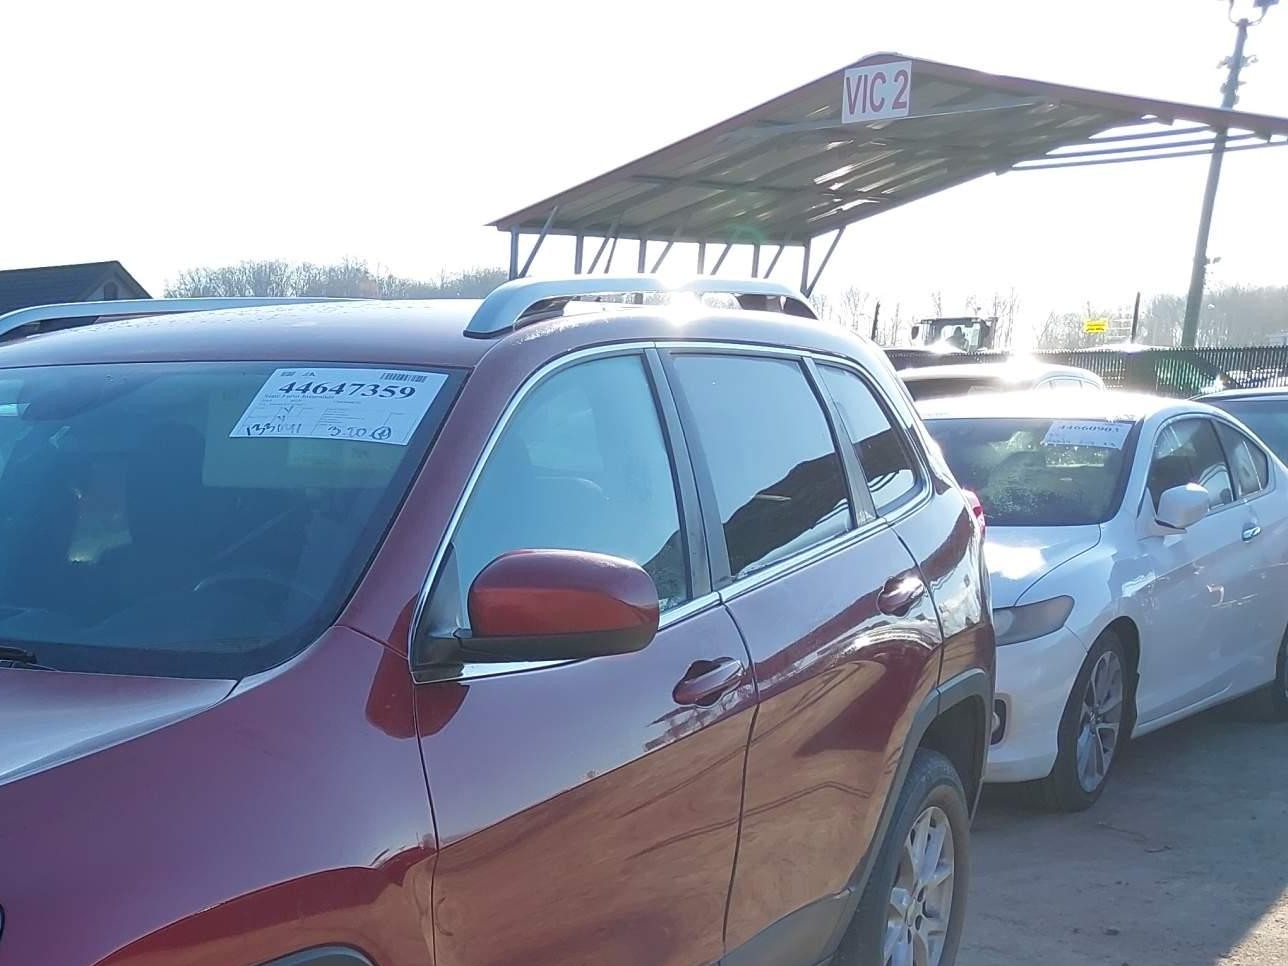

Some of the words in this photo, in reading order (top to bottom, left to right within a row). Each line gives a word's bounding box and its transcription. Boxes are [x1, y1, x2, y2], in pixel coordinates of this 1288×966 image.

[846, 72, 887, 115] VIC
[892, 69, 909, 110] 2
[279, 381, 416, 399] 44647359
